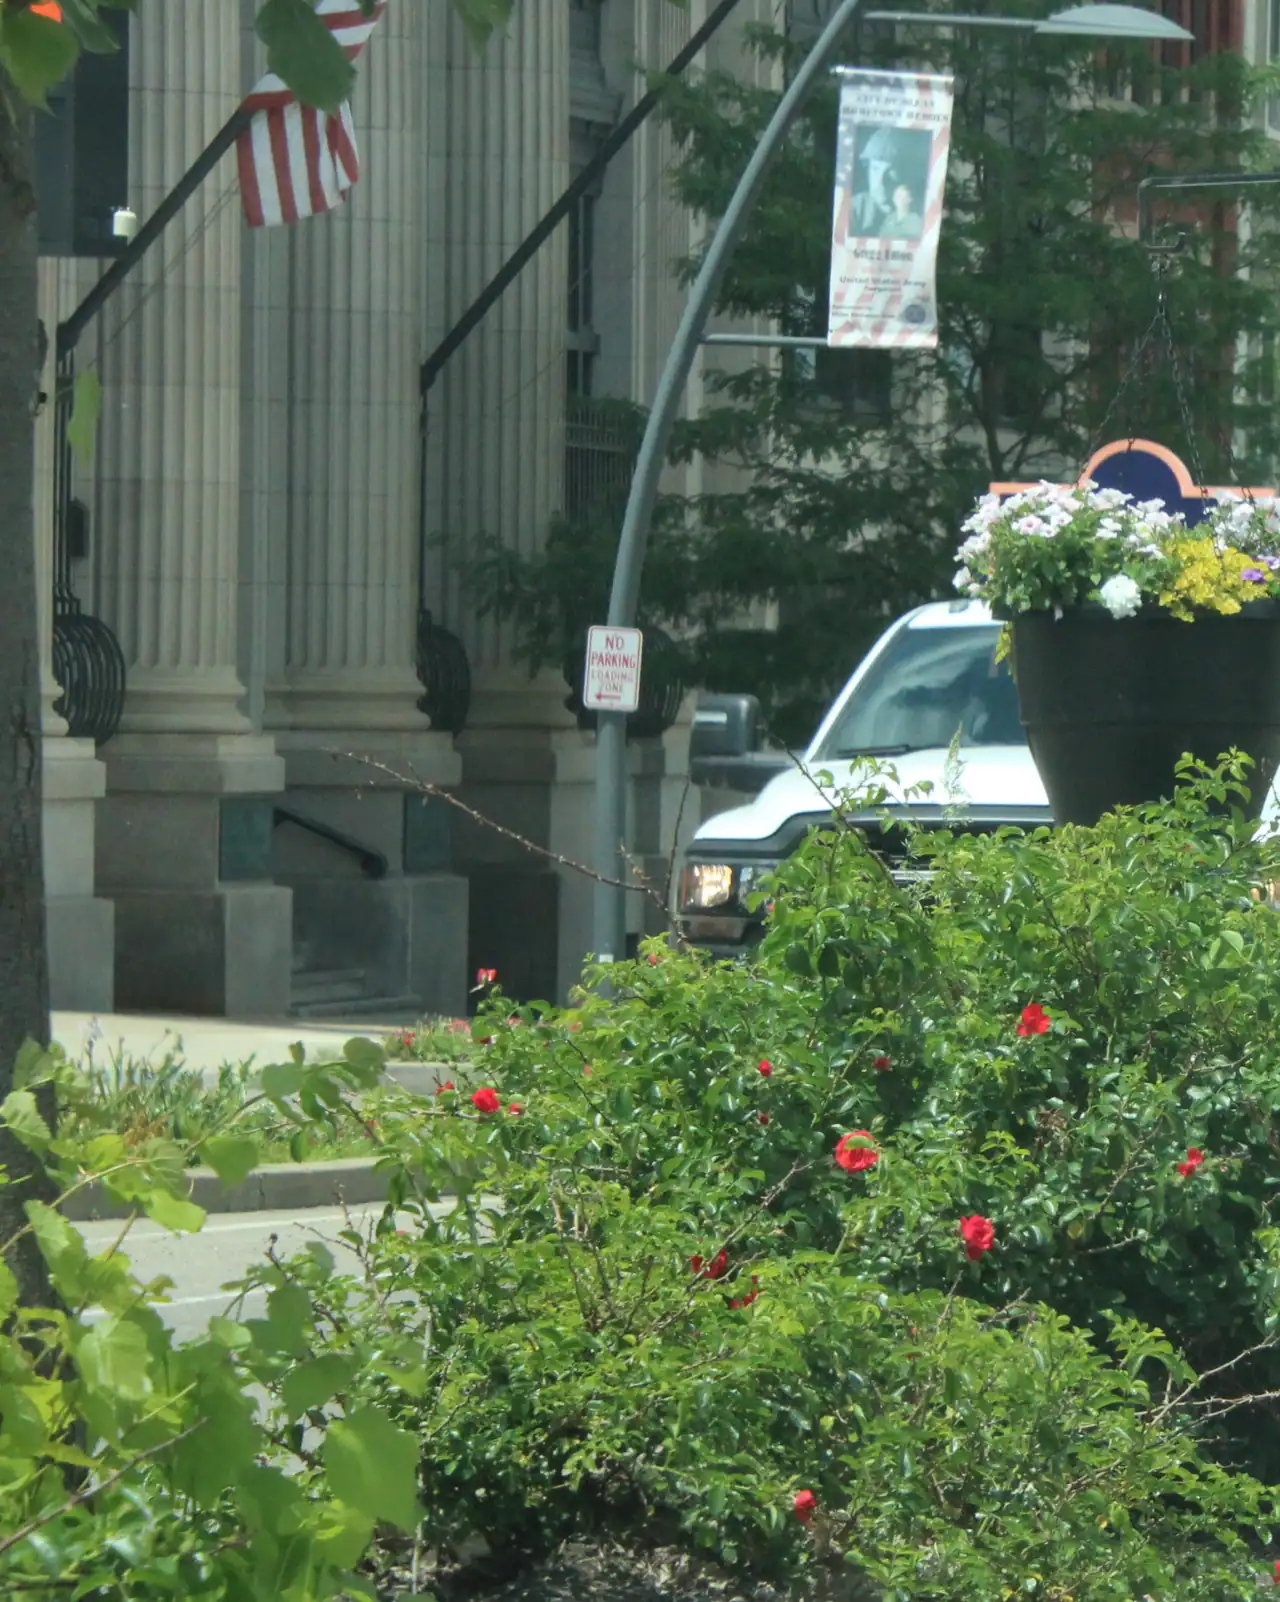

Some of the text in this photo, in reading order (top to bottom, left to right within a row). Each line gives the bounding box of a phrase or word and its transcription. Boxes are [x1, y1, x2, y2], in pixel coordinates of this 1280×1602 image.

[605, 635, 624, 650] NO
[591, 652, 636, 668] PARKING
[591, 670, 634, 682] LOADING
[599, 682, 623, 694] ZONE
